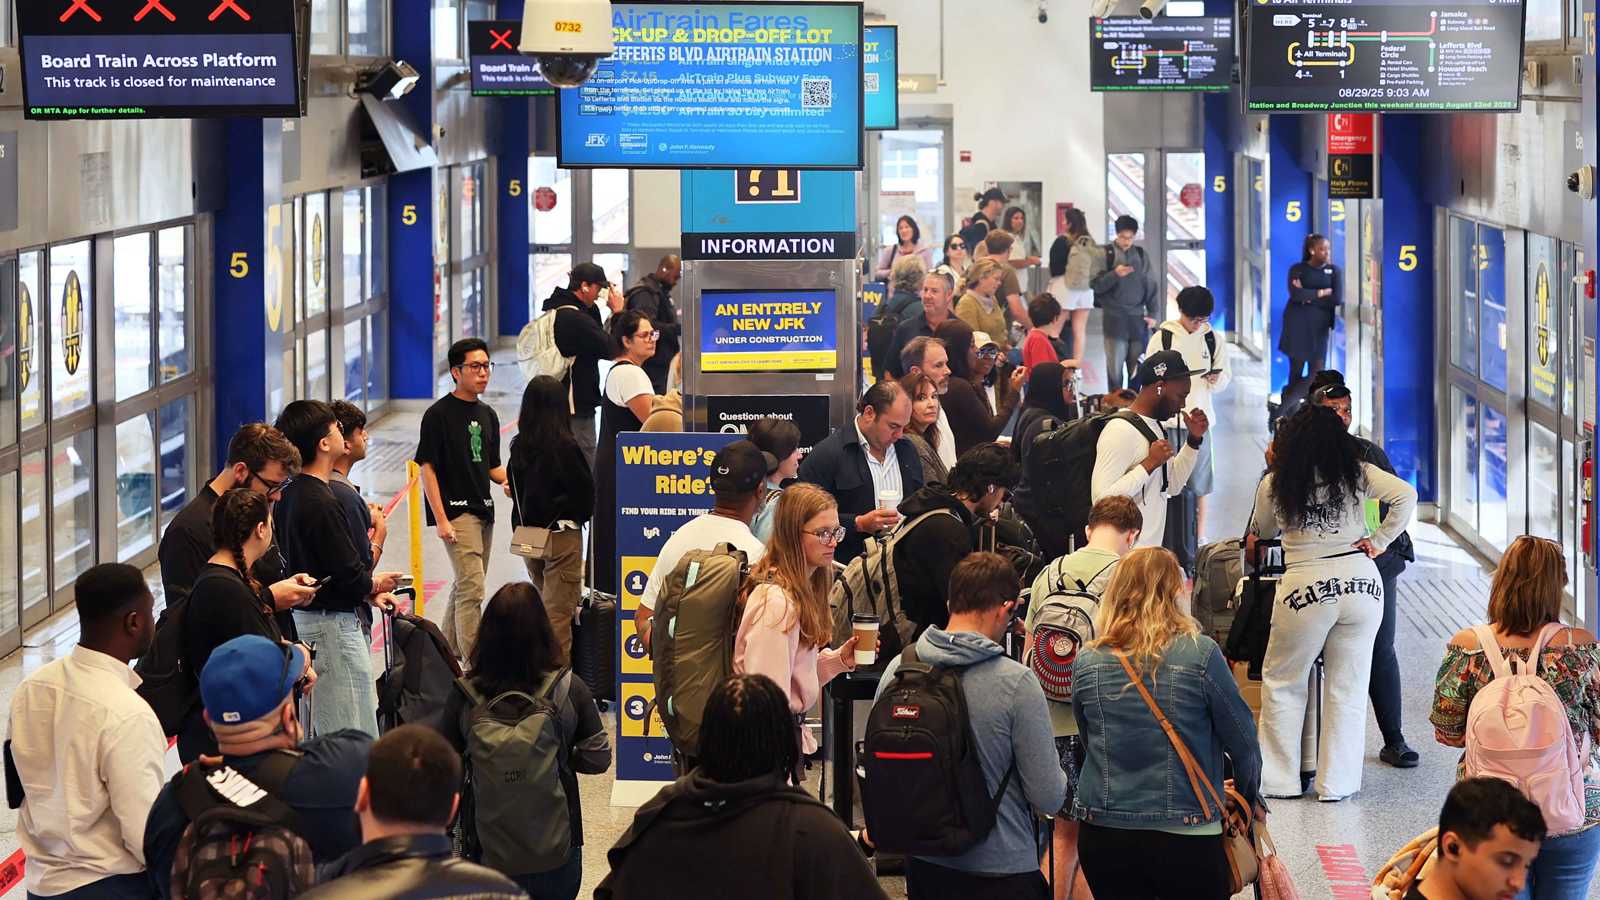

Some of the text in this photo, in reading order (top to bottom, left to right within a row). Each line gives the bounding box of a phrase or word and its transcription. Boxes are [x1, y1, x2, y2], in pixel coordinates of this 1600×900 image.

[612, 9, 809, 30] AirTrain Fares
[1308, 18, 1348, 28] 5 7 8
[555, 22, 581, 33] 0732
[672, 28, 688, 43] &
[692, 28, 791, 43] DROP-OFF
[795, 28, 832, 43] LOT
[41, 53, 277, 68] Board Train Across Platform
[669, 46, 704, 62] BLVD
[707, 46, 772, 62] AIRTRAIN
[775, 46, 832, 62] STATION
[480, 64, 506, 73] Board
[508, 64, 531, 73] Train
[1295, 70, 1345, 79] 4 1
[44, 76, 277, 88] This track is closed for maintenance
[755, 72, 799, 86] Subway
[1338, 88, 1430, 98] 08/29/25 9:03 AM
[30, 106, 146, 116] OR MTA App for further details.
[1291, 102, 1329, 110] Broadway
[1415, 102, 1444, 110] starting
[1446, 102, 1473, 110] August
[586, 136, 605, 145] JFK
[509, 179, 521, 197] 5
[1213, 175, 1226, 194] 5
[1330, 180, 1346, 188] Help
[402, 204, 418, 226] 5
[1286, 201, 1302, 222] 5
[701, 238, 836, 254] INFORMATION
[229, 253, 250, 279] 5
[1398, 245, 1419, 272] 5
[863, 290, 883, 306] My
[715, 302, 823, 317] AN ENTIRELY
[733, 317, 806, 331] NEW JFK
[715, 335, 824, 344] UNDER CONSTRUCTION
[719, 411, 793, 421] Questions about
[622, 446, 717, 467] Where's
[621, 507, 639, 515] FIND
[640, 507, 658, 515] YOUR
[632, 575, 643, 590] 1
[630, 700, 644, 715] 3
